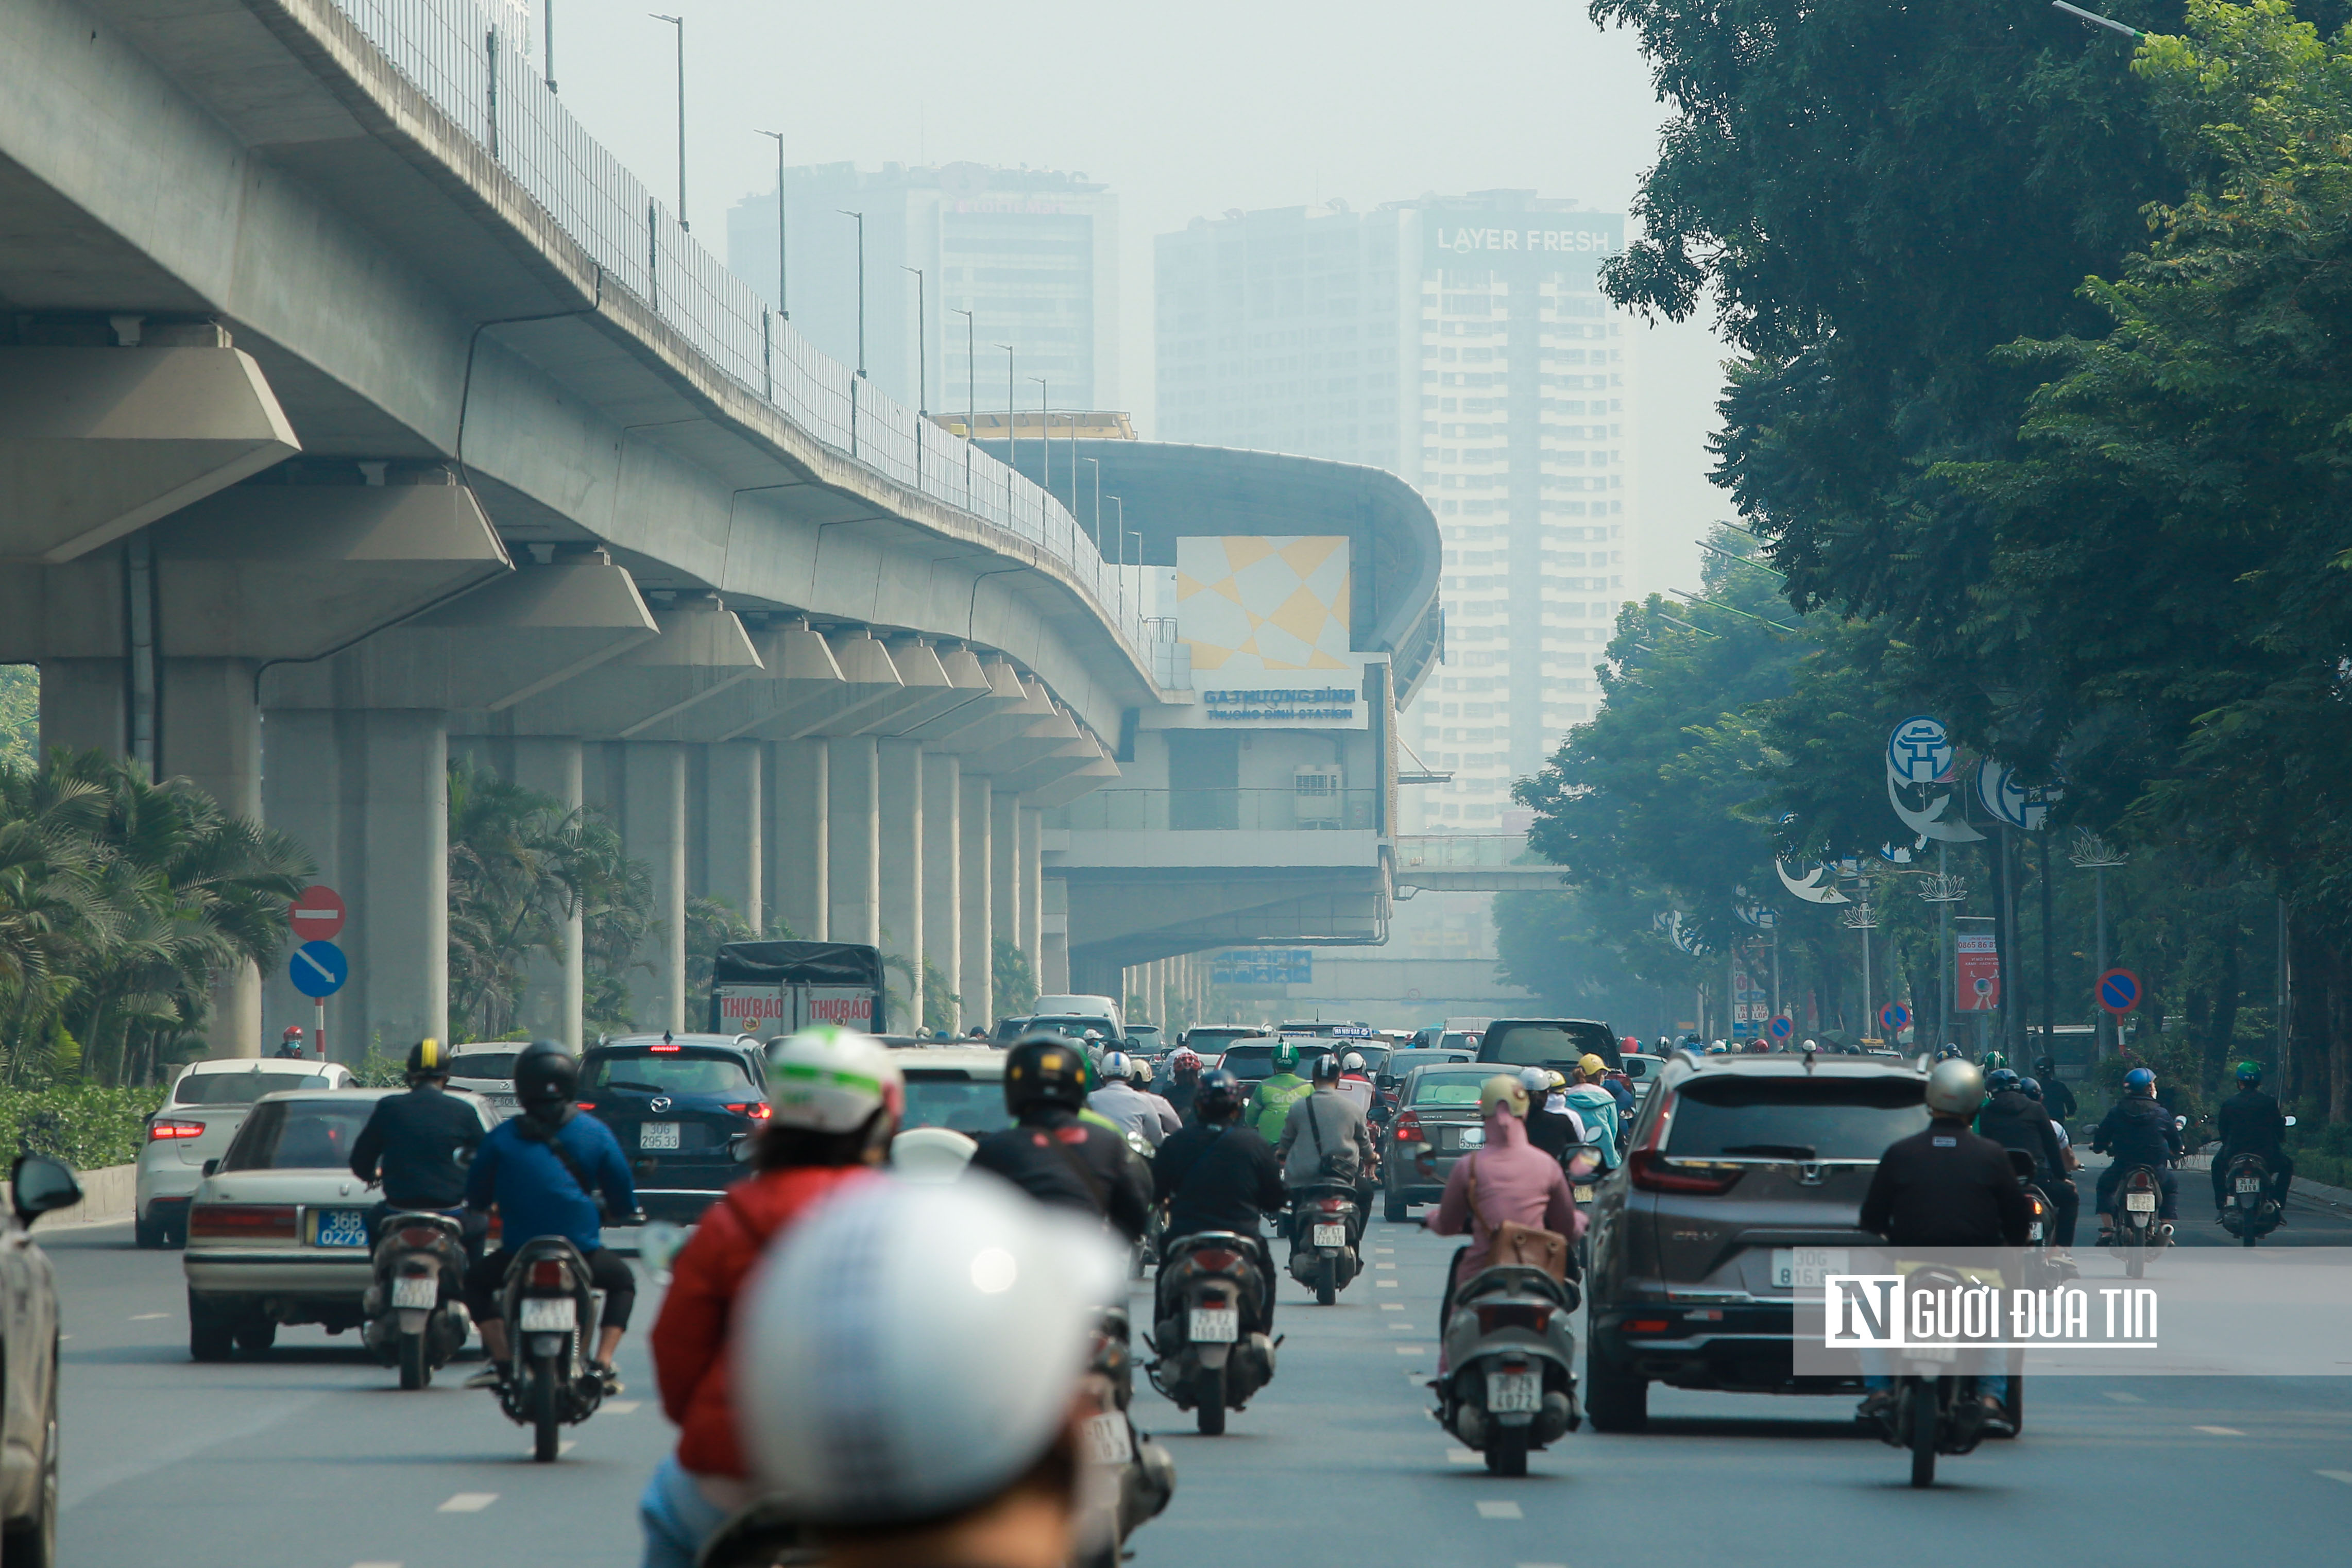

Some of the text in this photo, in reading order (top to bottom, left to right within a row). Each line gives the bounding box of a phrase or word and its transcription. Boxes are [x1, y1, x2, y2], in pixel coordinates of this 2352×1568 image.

[1438, 228, 1609, 253] LAYER FRESH
[1299, 708, 1352, 719] STATION
[651, 1123, 670, 1135] 30G
[642, 1135, 677, 1148] 295.33
[329, 1212, 362, 1230] 36B
[321, 1229, 367, 1245] 0279
[1796, 1251, 1827, 1266] 30G
